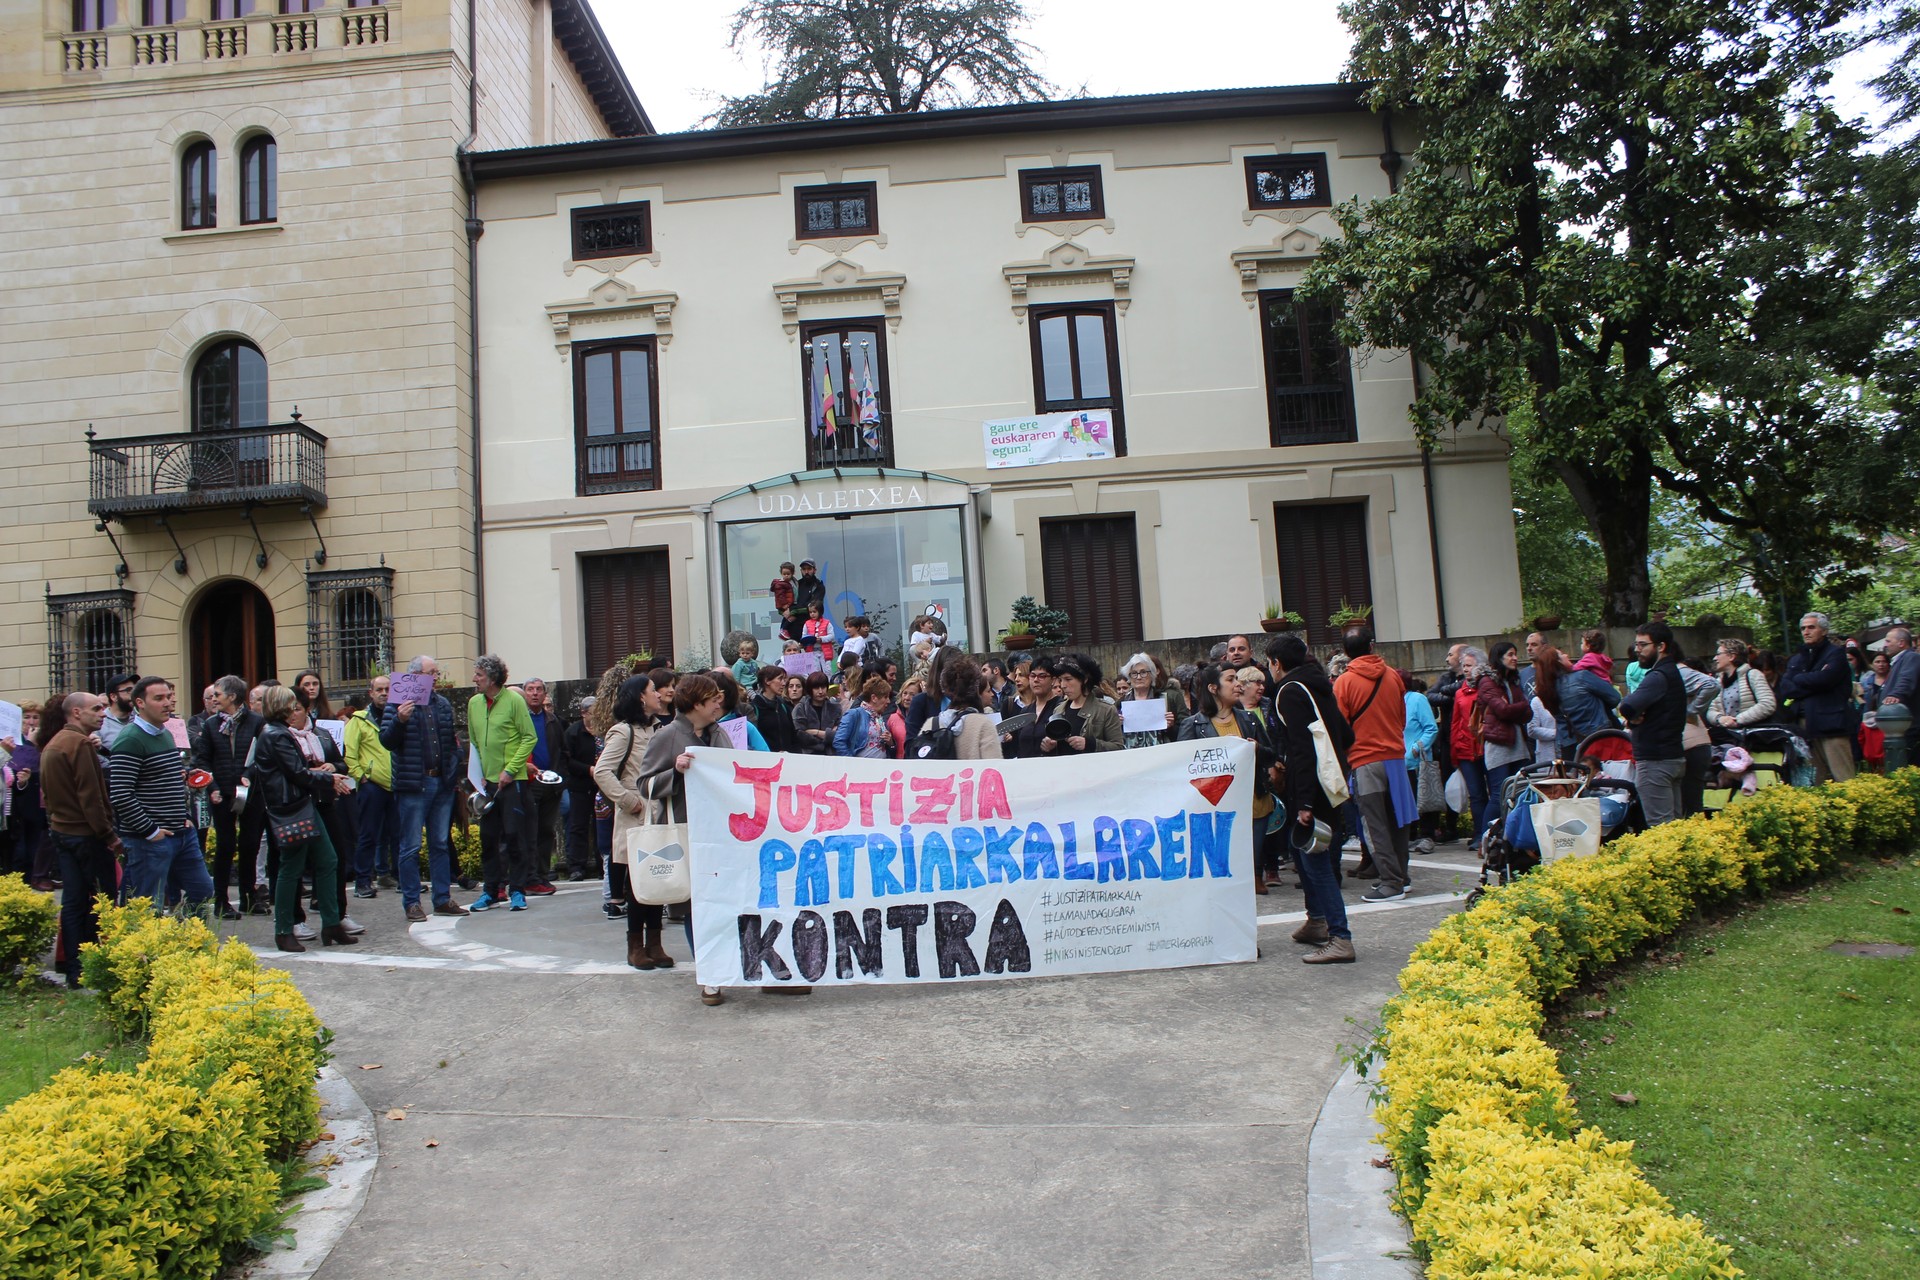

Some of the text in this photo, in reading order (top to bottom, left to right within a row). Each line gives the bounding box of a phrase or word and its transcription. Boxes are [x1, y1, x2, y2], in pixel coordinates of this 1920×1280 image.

[990, 421, 1039, 436] gaur ere
[991, 430, 1056, 445] euskararen
[992, 443, 1031, 458] eguna!
[758, 485, 924, 514] UDALETXEA
[737, 898, 1031, 981] KONTRA
